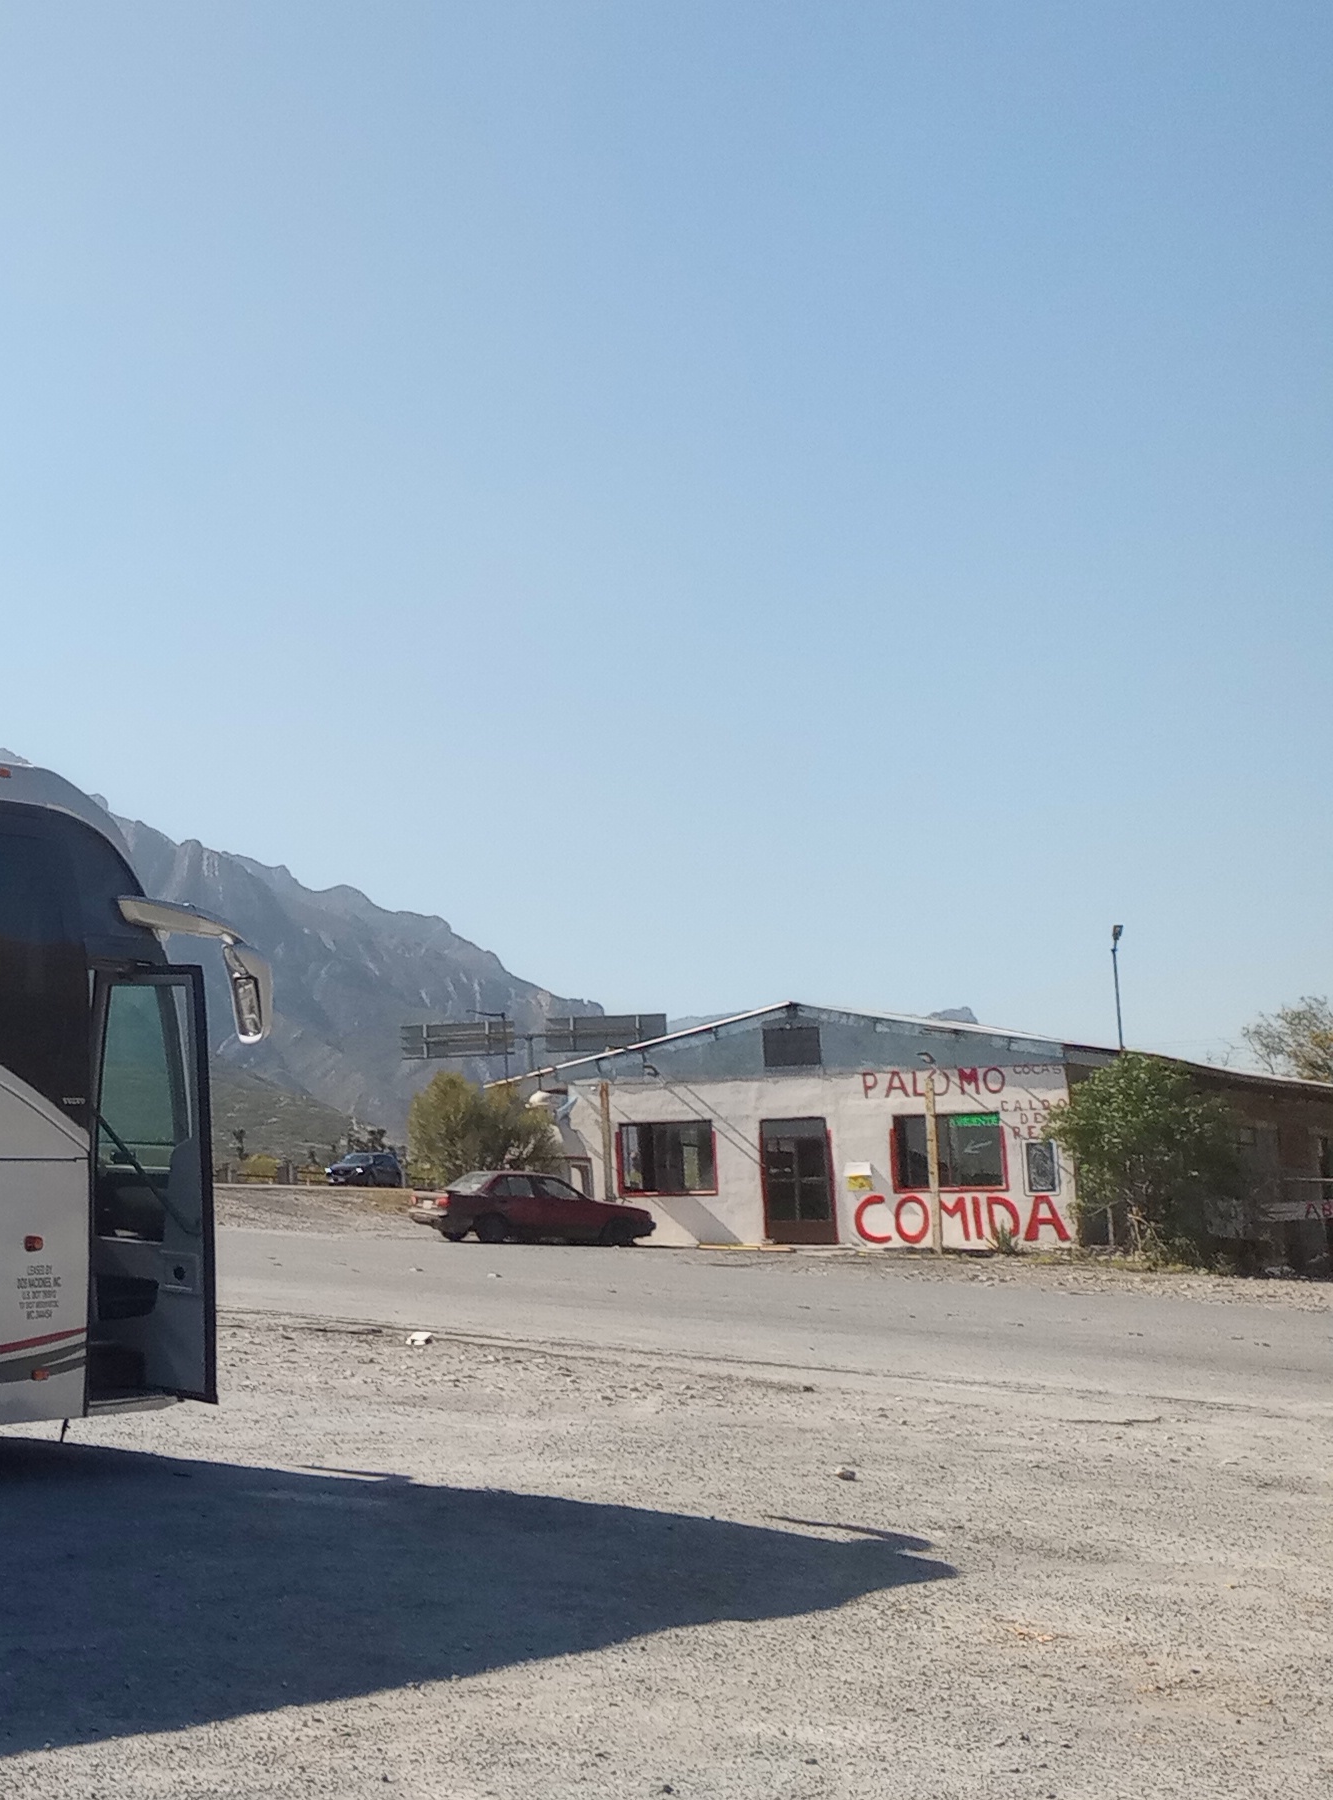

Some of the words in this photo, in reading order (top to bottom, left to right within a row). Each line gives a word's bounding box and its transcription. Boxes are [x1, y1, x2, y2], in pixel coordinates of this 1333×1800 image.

[862, 1066, 1006, 1099] PALOMO
[1000, 1098, 1069, 1113] CALDO
[854, 1194, 1072, 1245] COMIDA
